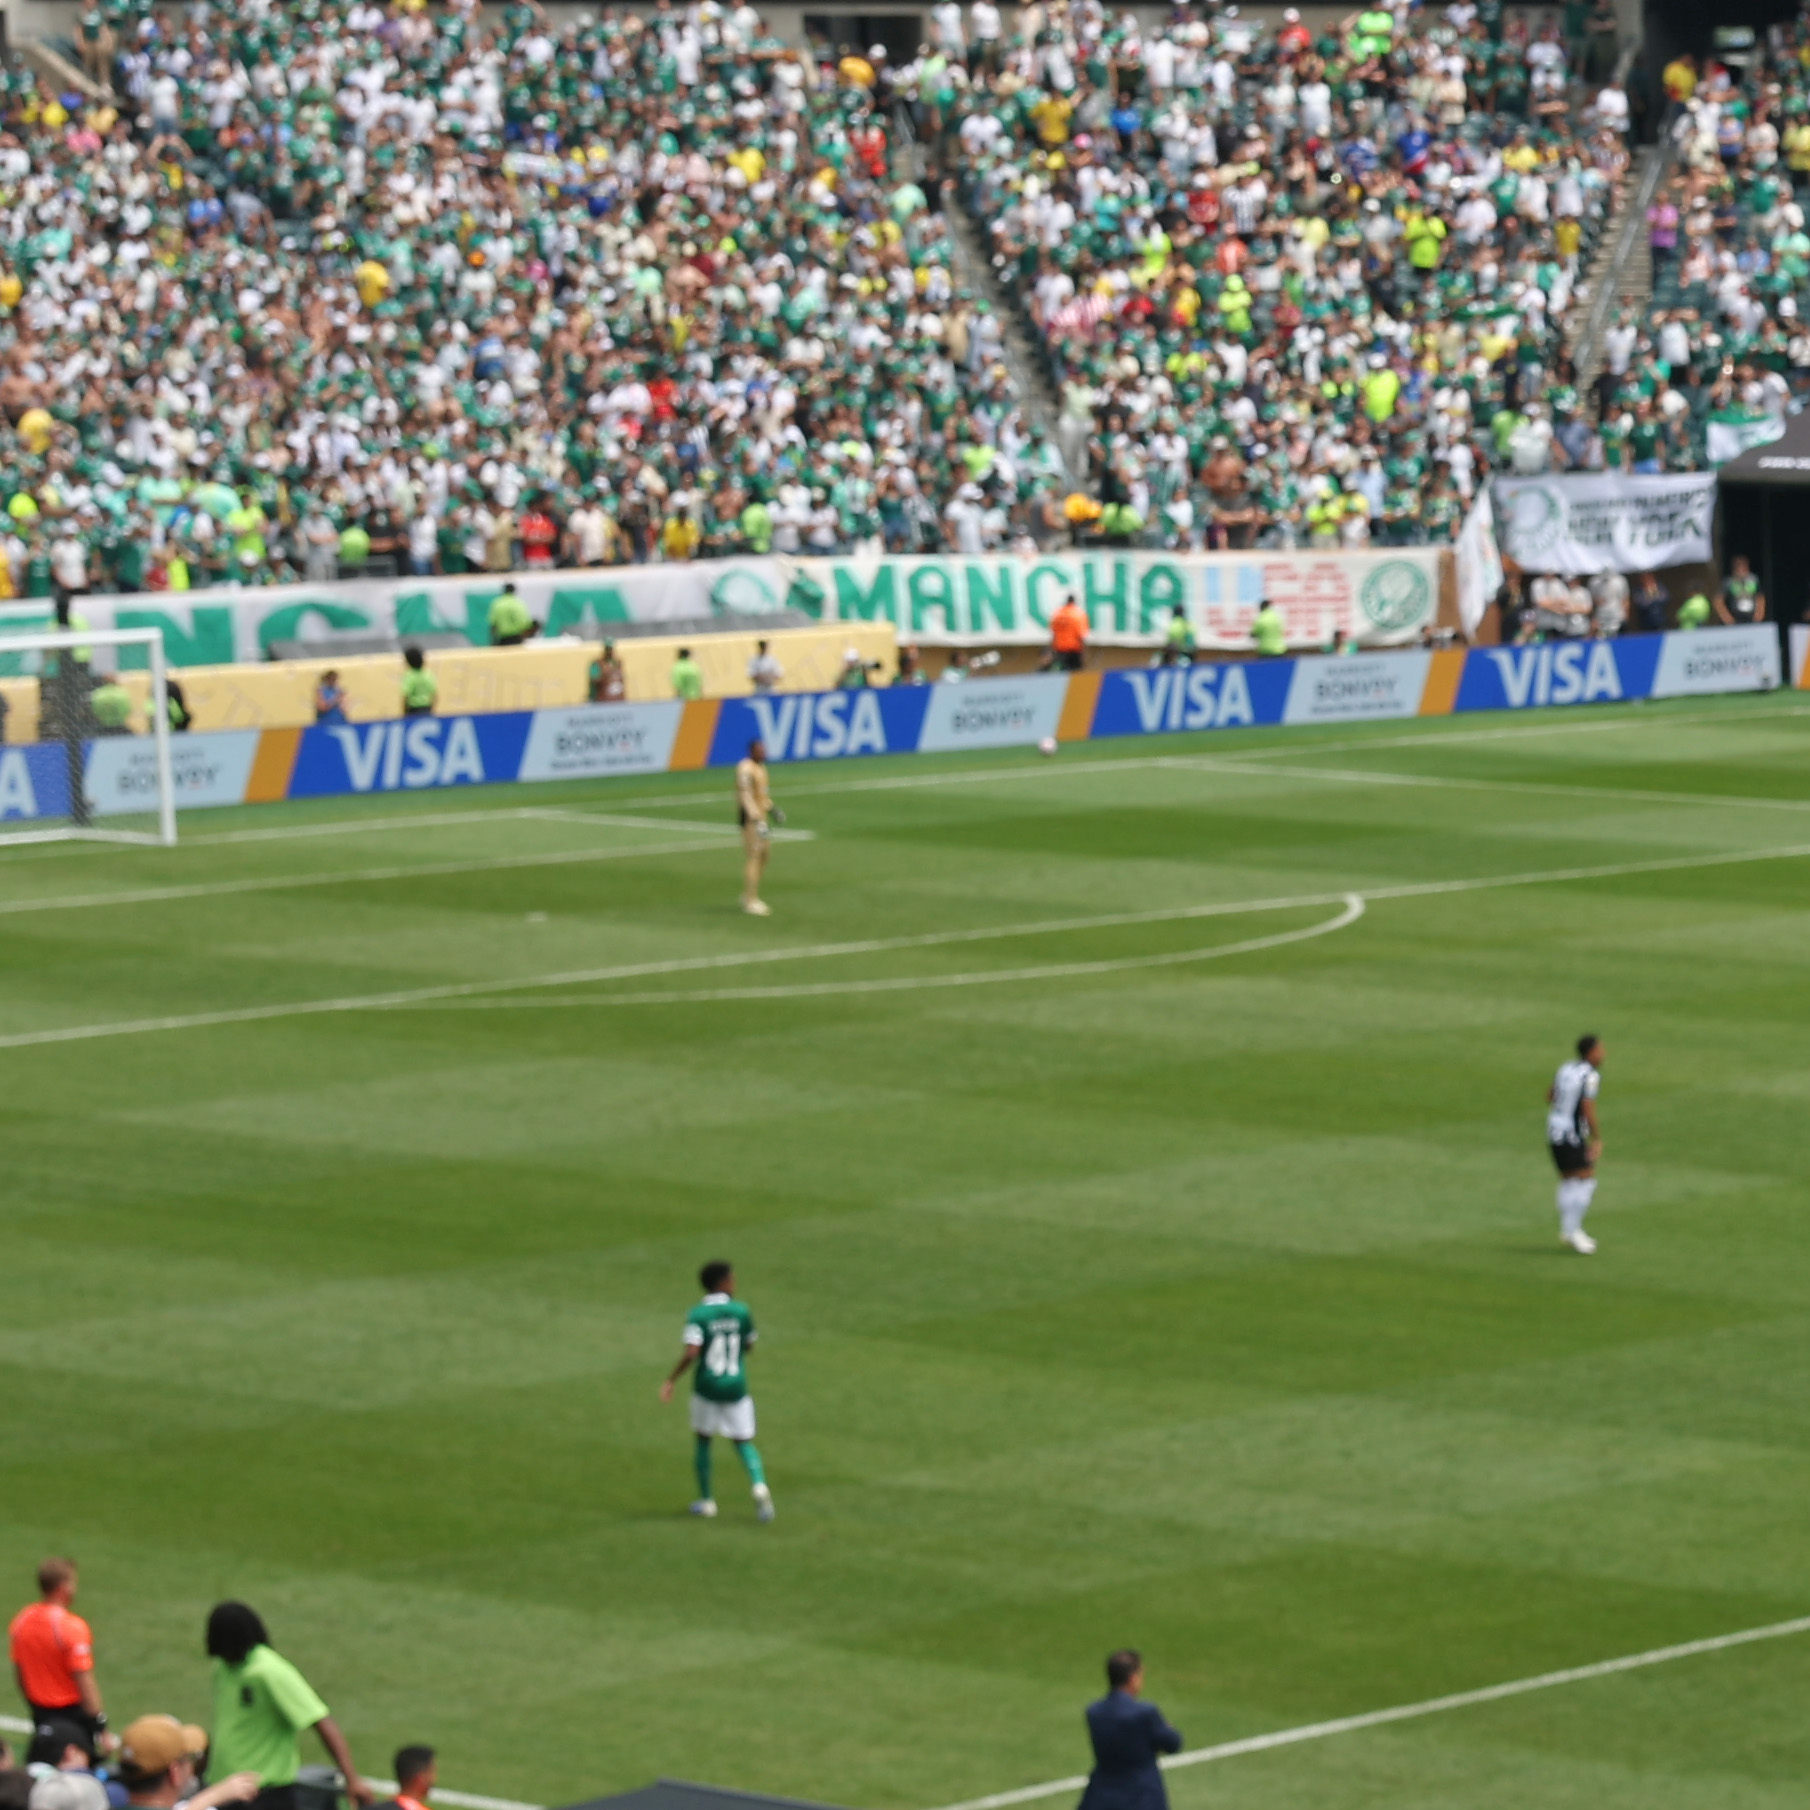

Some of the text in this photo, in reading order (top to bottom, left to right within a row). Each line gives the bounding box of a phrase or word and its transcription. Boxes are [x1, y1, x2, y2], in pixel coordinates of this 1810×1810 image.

[833, 560, 1184, 633] MANCHA
[1123, 664, 1255, 732] VISA
[1485, 642, 1623, 707] VISA
[327, 717, 485, 792] VISA
[745, 691, 887, 761] VISA
[705, 1332, 741, 1376] 41
